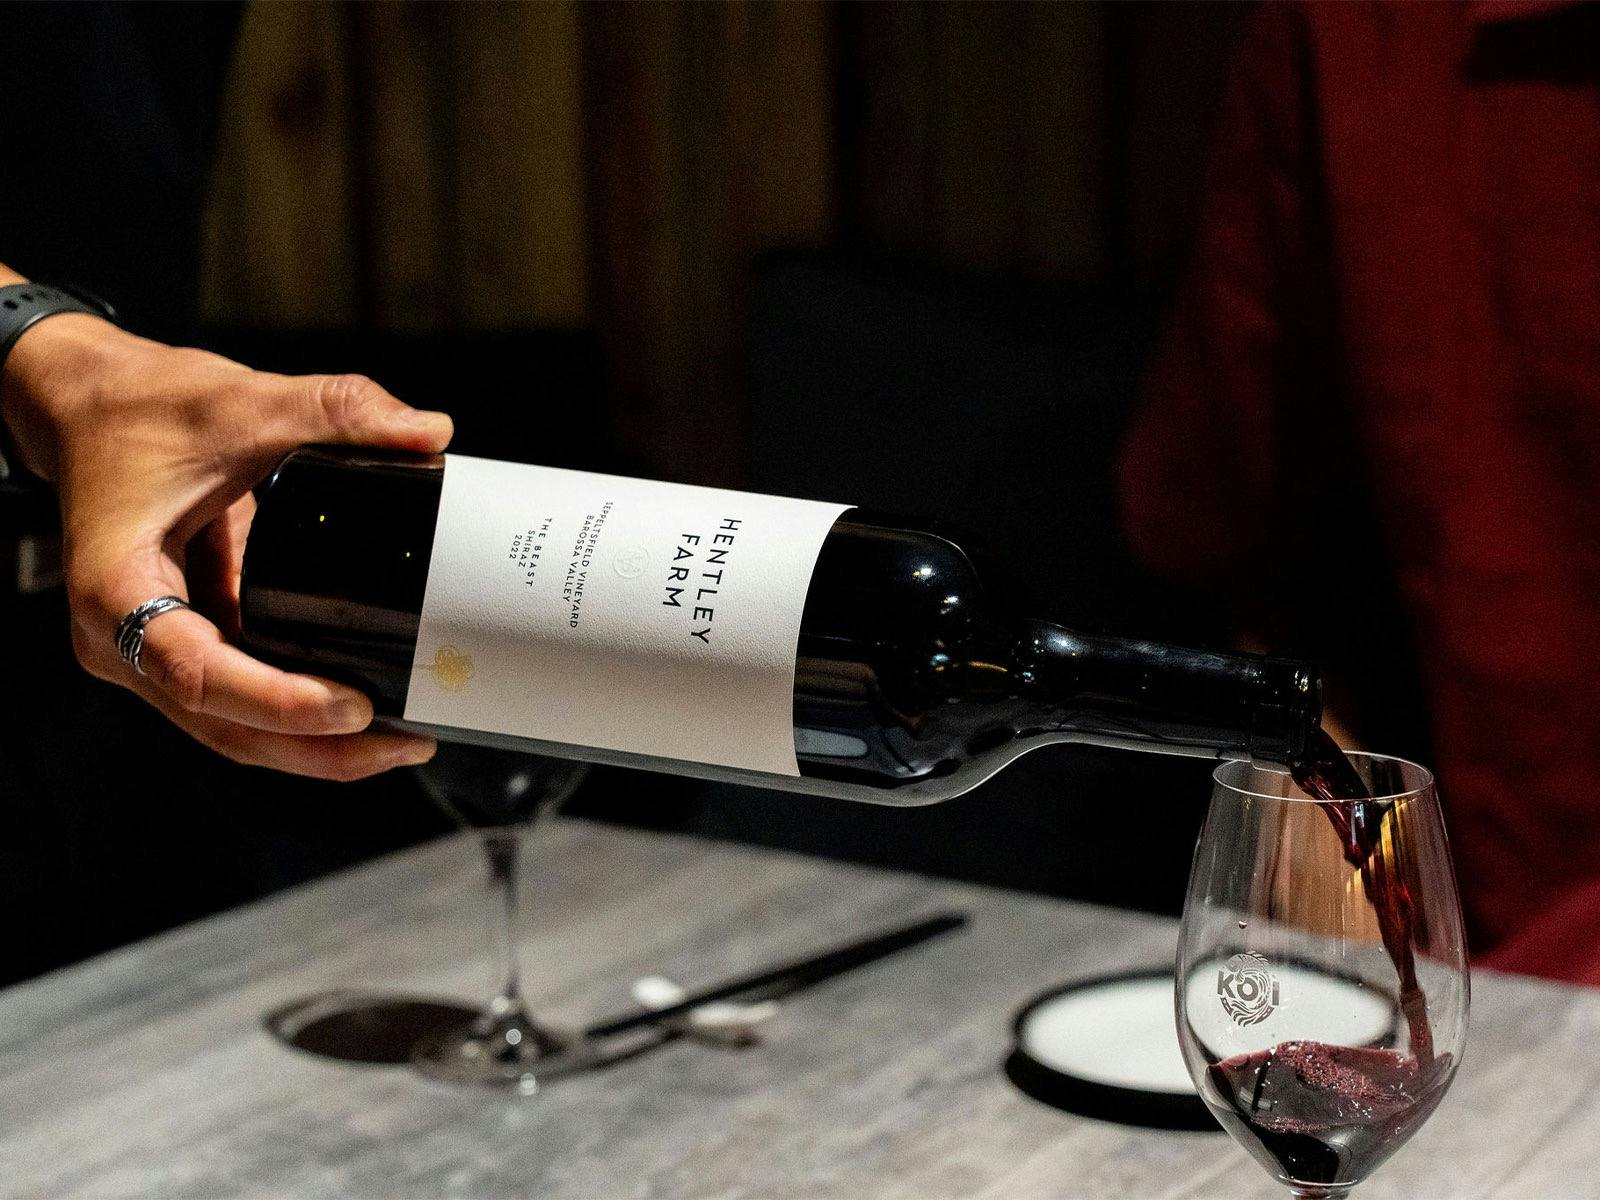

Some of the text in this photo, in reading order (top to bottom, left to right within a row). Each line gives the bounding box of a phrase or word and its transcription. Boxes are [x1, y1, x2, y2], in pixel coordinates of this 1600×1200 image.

[509, 534, 522, 559] 2022
[518, 530, 536, 568] SHIRAZ
[526, 518, 552, 587] THE BEAST
[563, 514, 595, 602] BAROSSA VALLEY
[570, 501, 614, 628] SEPPELTSFIELD VINEYARD
[662, 534, 701, 608] FARM
[691, 518, 742, 644] HENTLEY
